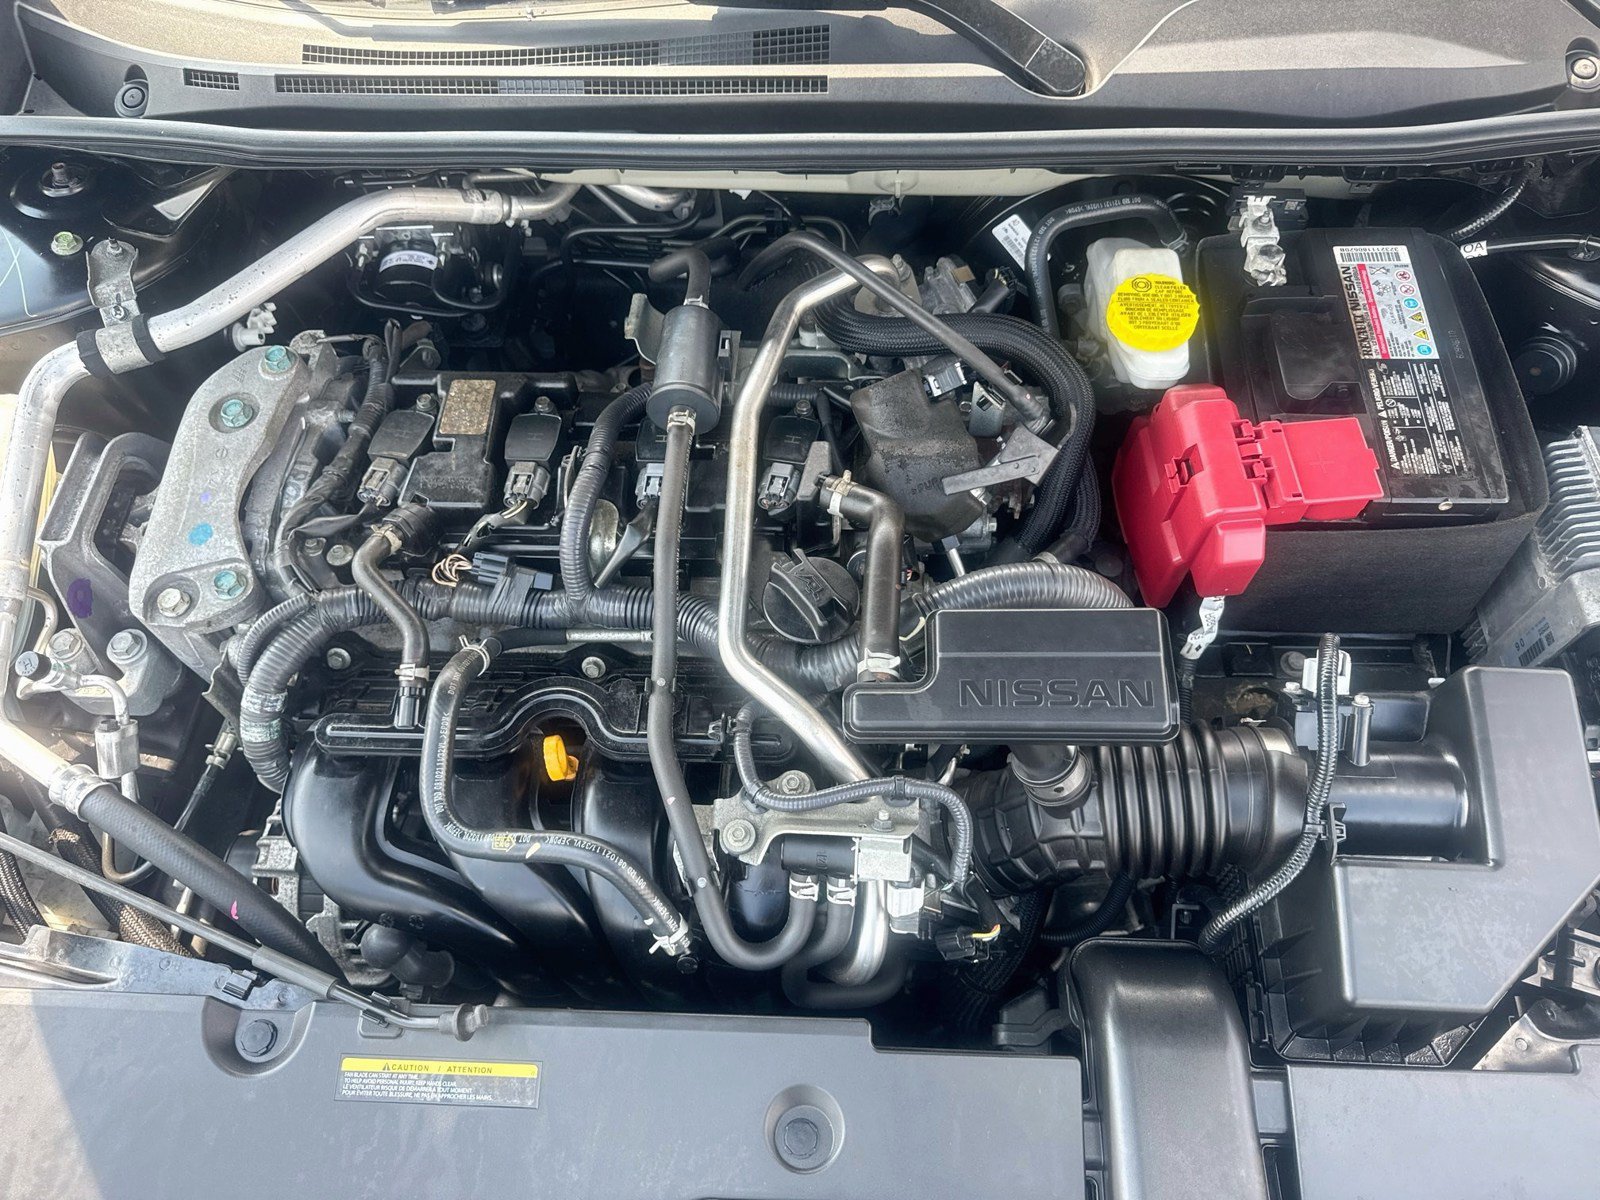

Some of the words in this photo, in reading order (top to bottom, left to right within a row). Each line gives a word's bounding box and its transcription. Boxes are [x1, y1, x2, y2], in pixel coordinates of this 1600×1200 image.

[1341, 266, 1361, 311] NISSAN
[958, 679, 1155, 708] NISSAN
[392, 1064, 430, 1072] CAUTION
[446, 1066, 492, 1074] ATTENTION
